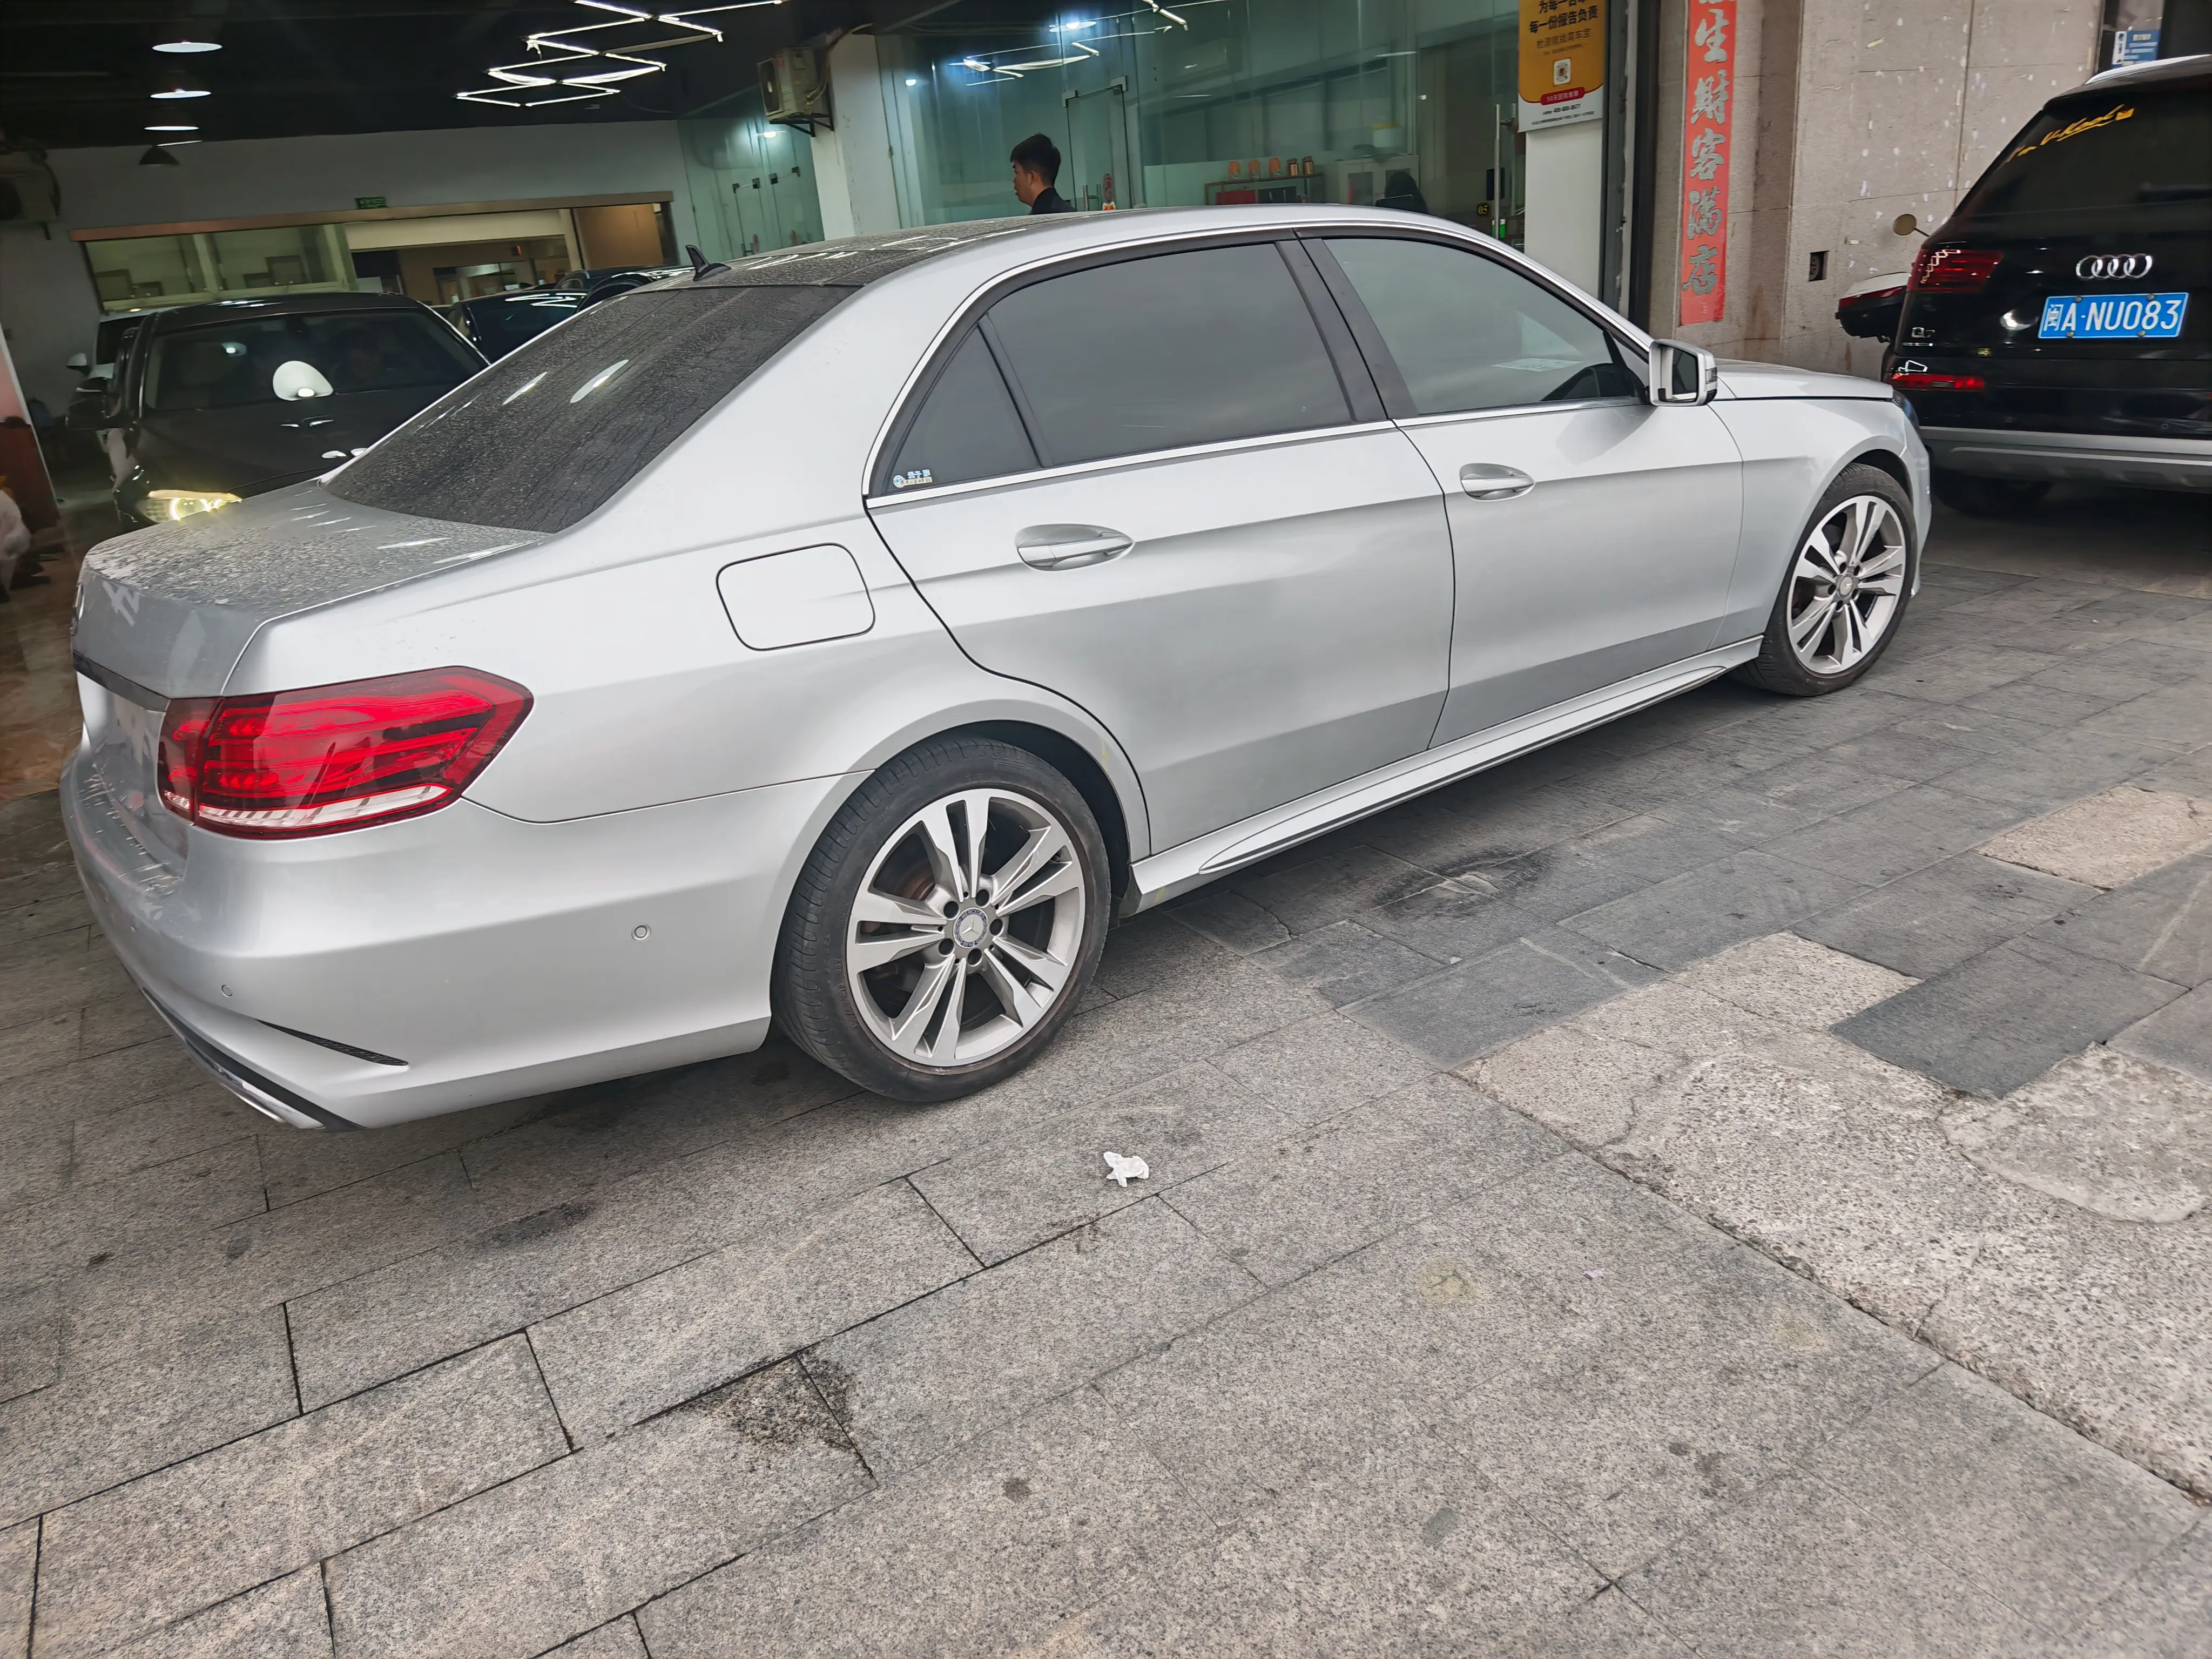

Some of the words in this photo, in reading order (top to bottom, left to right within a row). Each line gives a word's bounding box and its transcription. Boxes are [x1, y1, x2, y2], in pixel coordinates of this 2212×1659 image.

[1529, 5, 1598, 33] 每一份报告负责
[961, 909, 985, 919] MERCEDES
